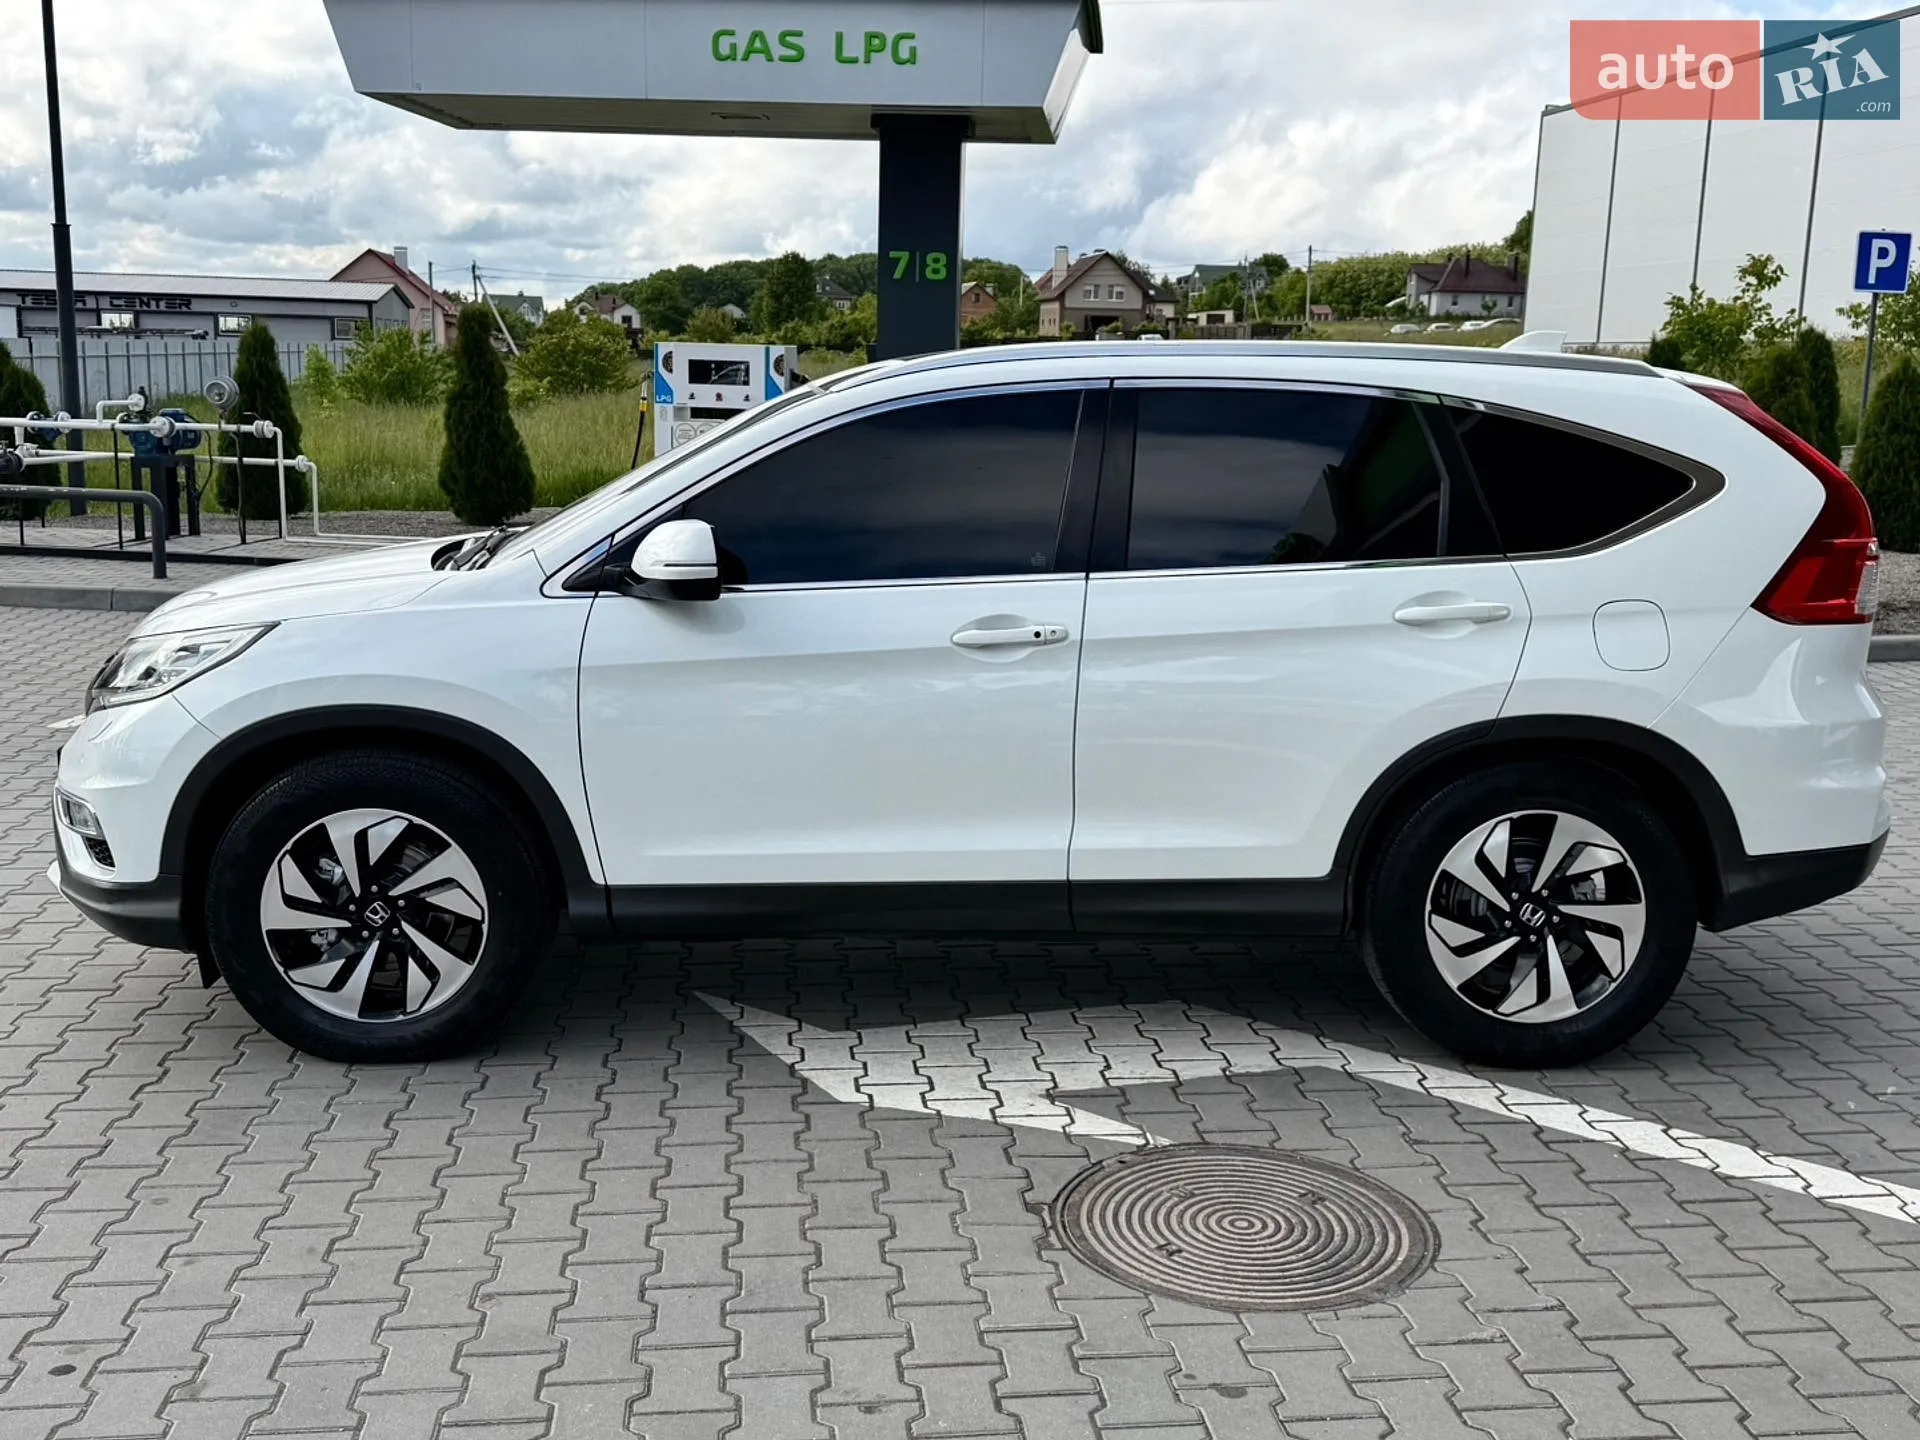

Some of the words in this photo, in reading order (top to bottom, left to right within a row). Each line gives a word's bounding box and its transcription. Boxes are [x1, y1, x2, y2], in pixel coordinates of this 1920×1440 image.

[711, 29, 805, 62] GAS
[834, 31, 918, 64] LPG
[1867, 238, 1897, 284] P
[16, 293, 87, 307] TESA
[107, 295, 193, 310] CENTER
[655, 394, 672, 402] LPG
